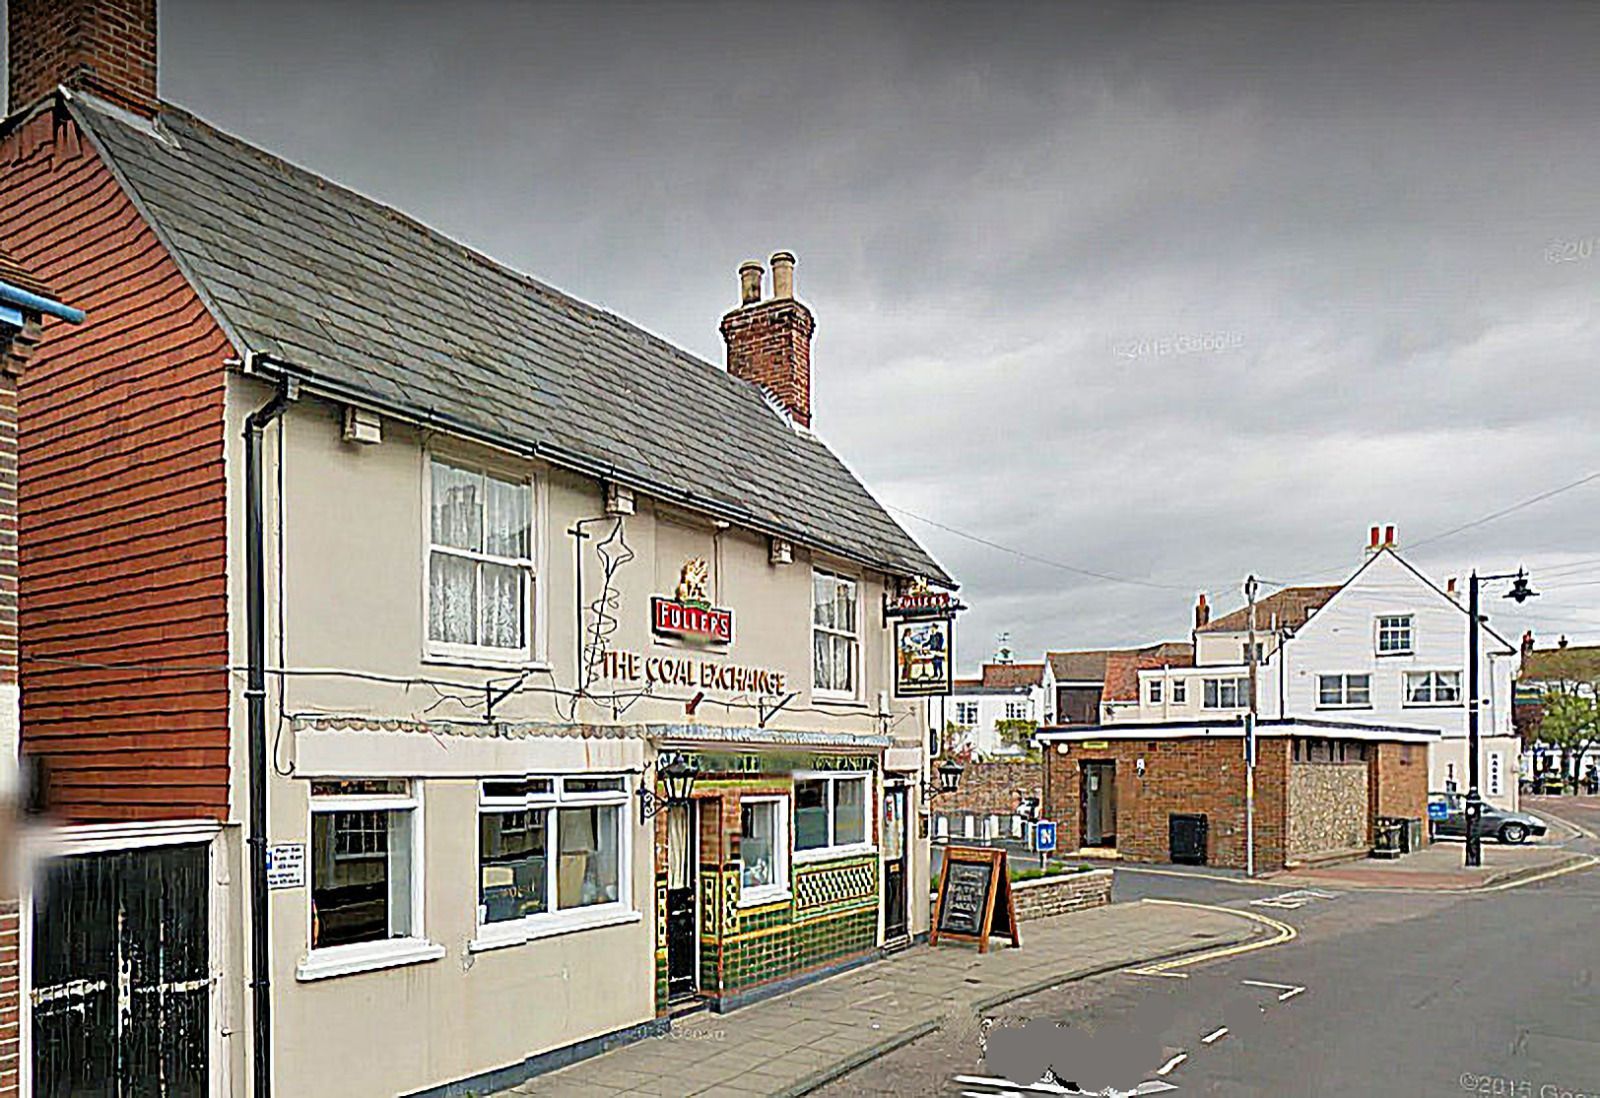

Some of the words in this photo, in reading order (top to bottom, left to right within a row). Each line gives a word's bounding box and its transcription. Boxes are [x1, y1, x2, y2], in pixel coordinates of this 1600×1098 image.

[602, 651, 641, 681] THE
[645, 656, 697, 687] COAL
[700, 662, 785, 696] EXCHANGE
